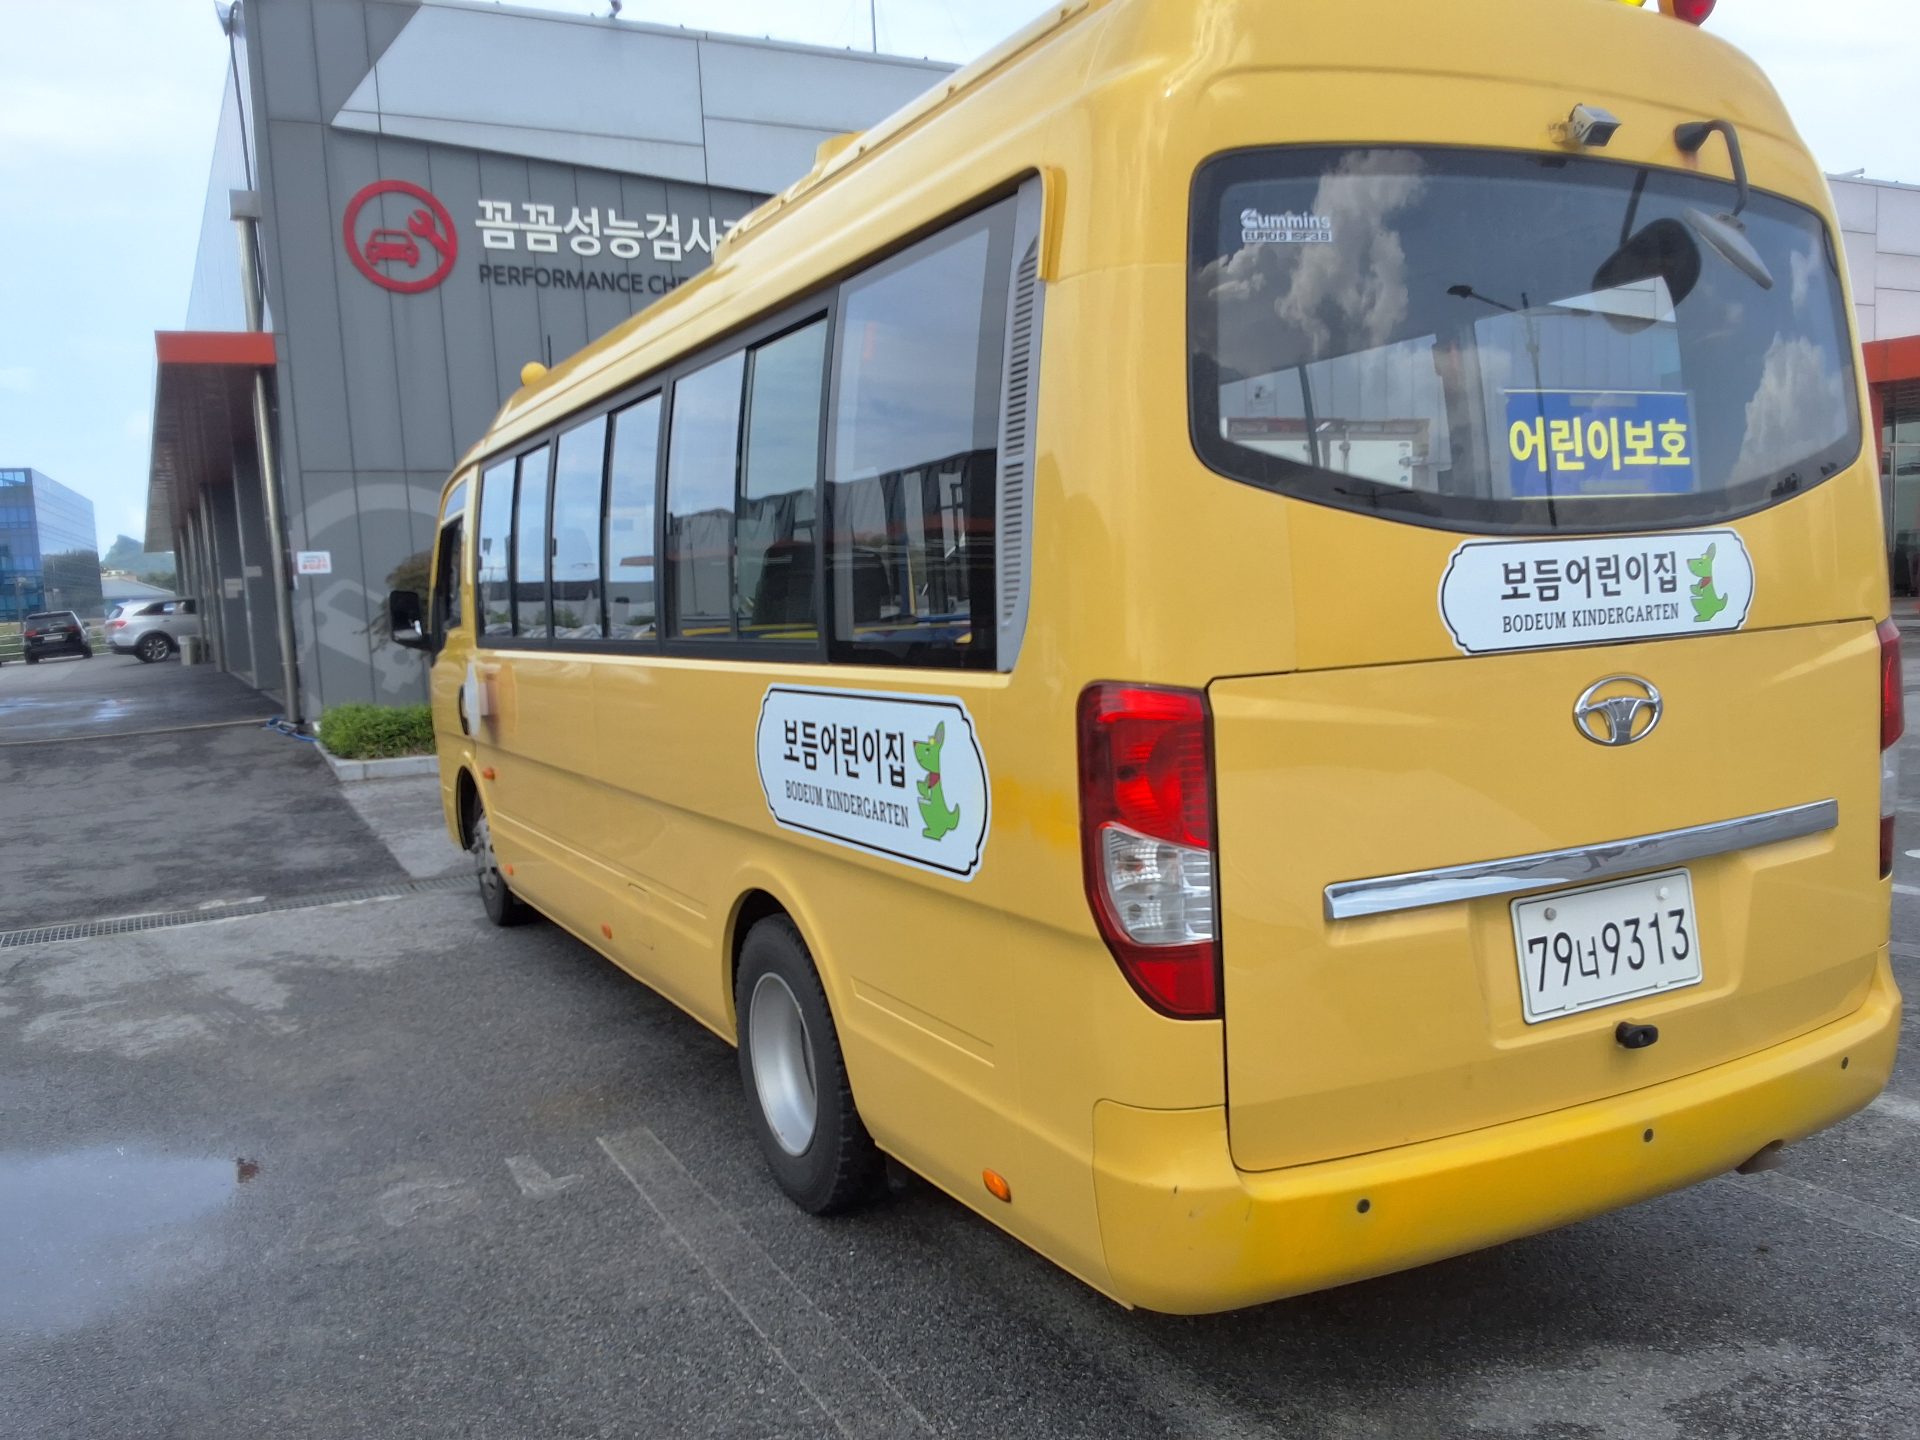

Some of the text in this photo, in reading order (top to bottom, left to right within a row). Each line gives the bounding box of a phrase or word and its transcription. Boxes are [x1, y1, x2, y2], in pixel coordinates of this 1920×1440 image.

[1241, 208, 1331, 229] Cummins
[479, 263, 644, 294] PERFORMANCE
[1509, 416, 1691, 472] 어린이보호
[1500, 551, 1678, 602] 보듬어린이집
[1502, 603, 1679, 633] BODEUM KINDERGARTEN
[783, 719, 906, 789] 보듬어린이집
[785, 779, 909, 828] BODEUM KINDERGARTEN
[1527, 908, 1690, 992] 79너9313
